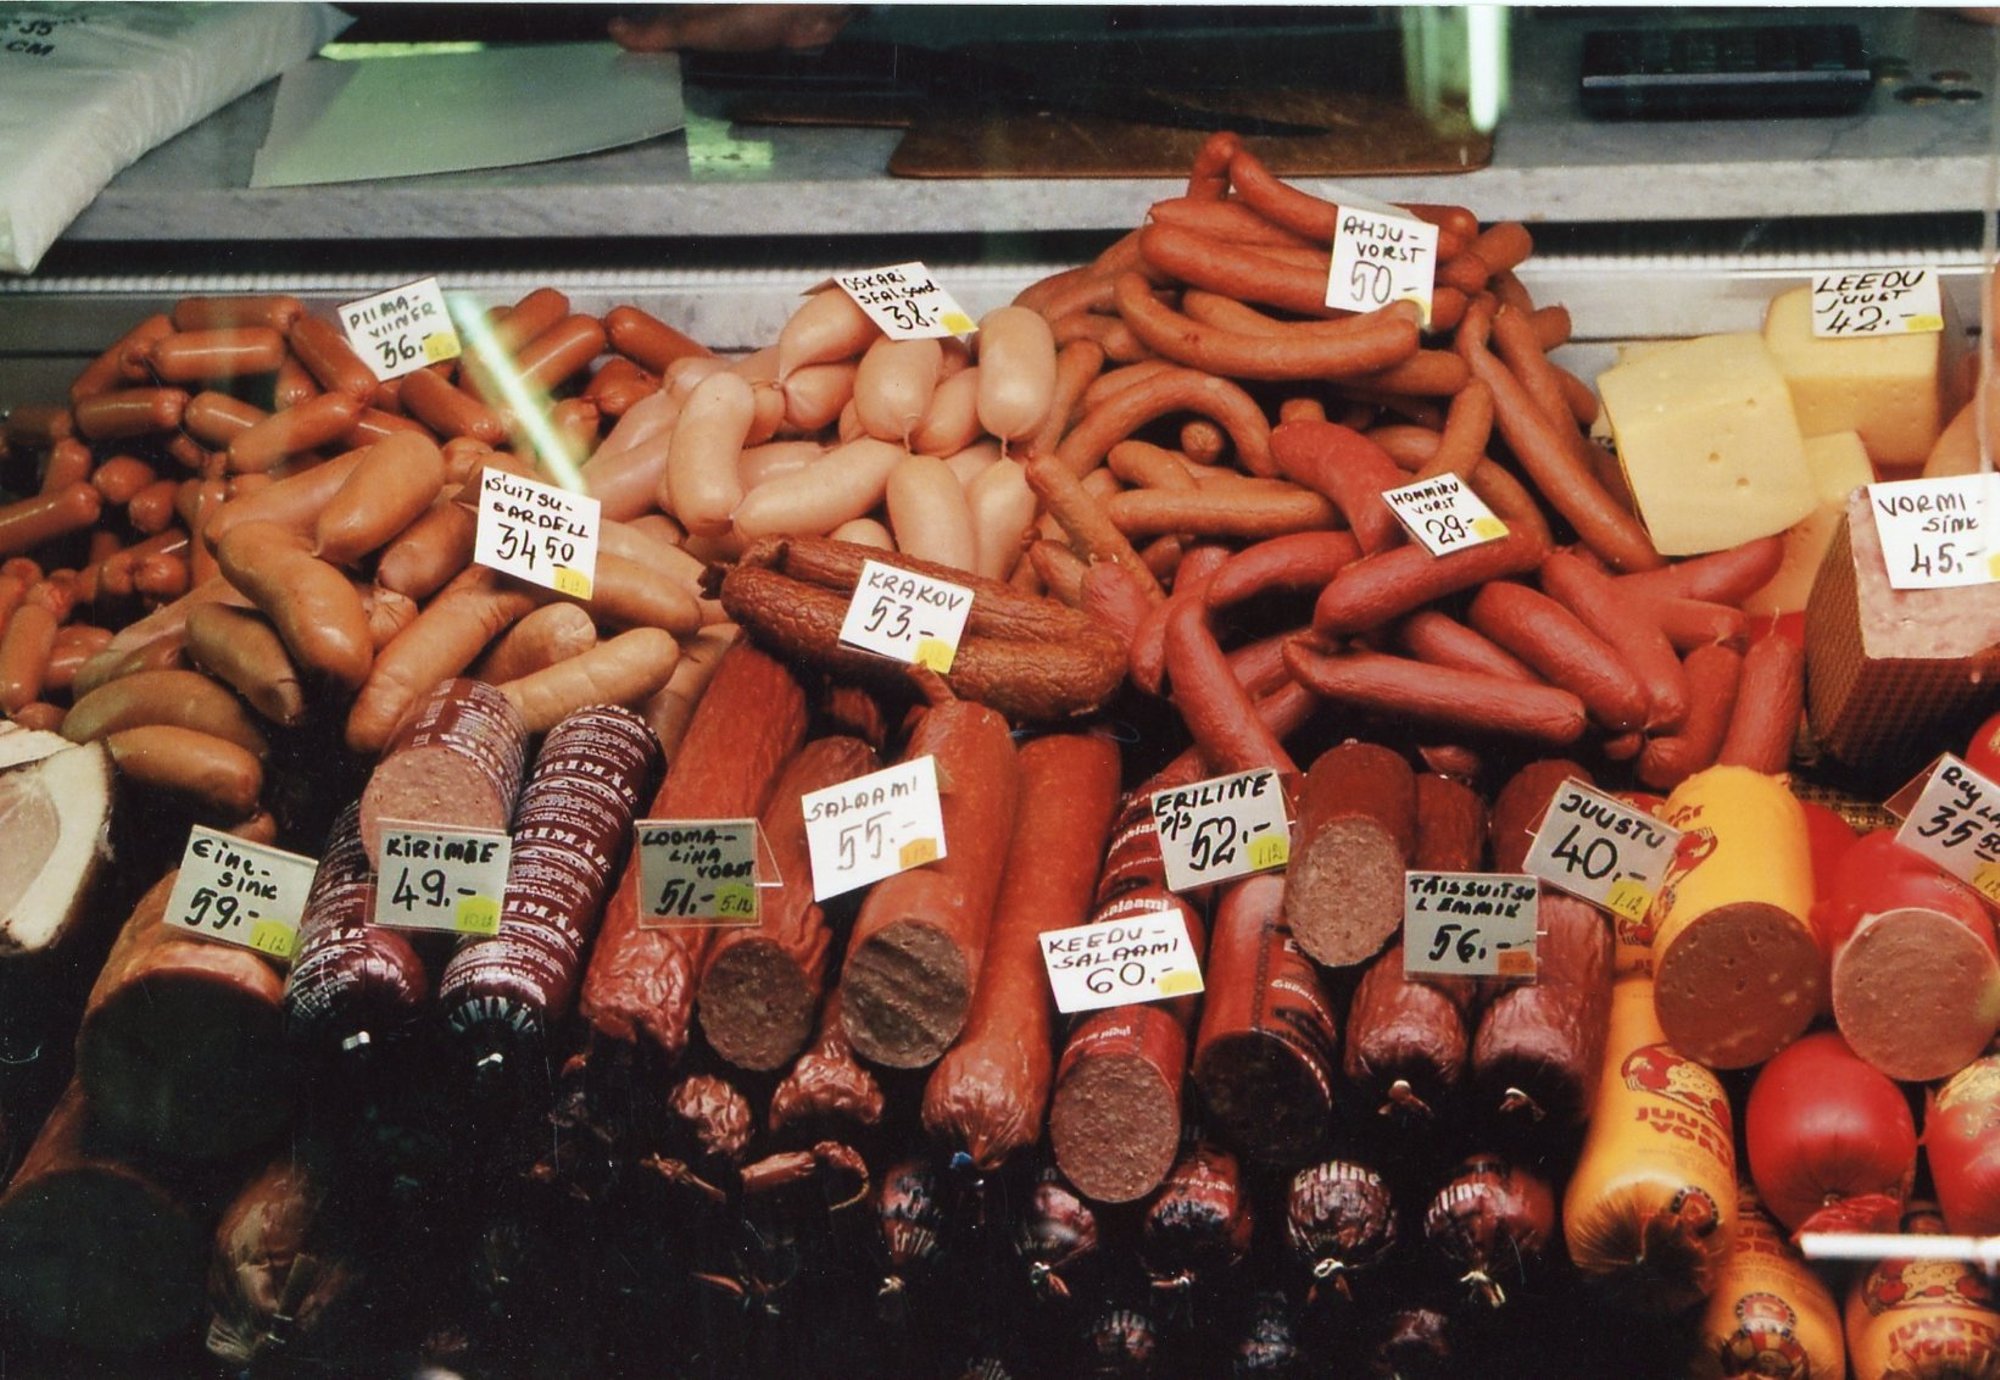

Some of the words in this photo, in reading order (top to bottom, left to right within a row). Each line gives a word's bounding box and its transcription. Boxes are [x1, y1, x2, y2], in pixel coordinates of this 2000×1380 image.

[1356, 241, 1427, 263] VORST
[1814, 270, 1925, 294] LEEDU
[368, 301, 438, 339] VIINER
[867, 571, 965, 611] KRAKOV
[805, 775, 917, 823] SALAAMI
[1154, 772, 1274, 818] ERILINE
[1559, 793, 1667, 849] JUUSTU
[1052, 937, 1179, 970] SALAAMI
